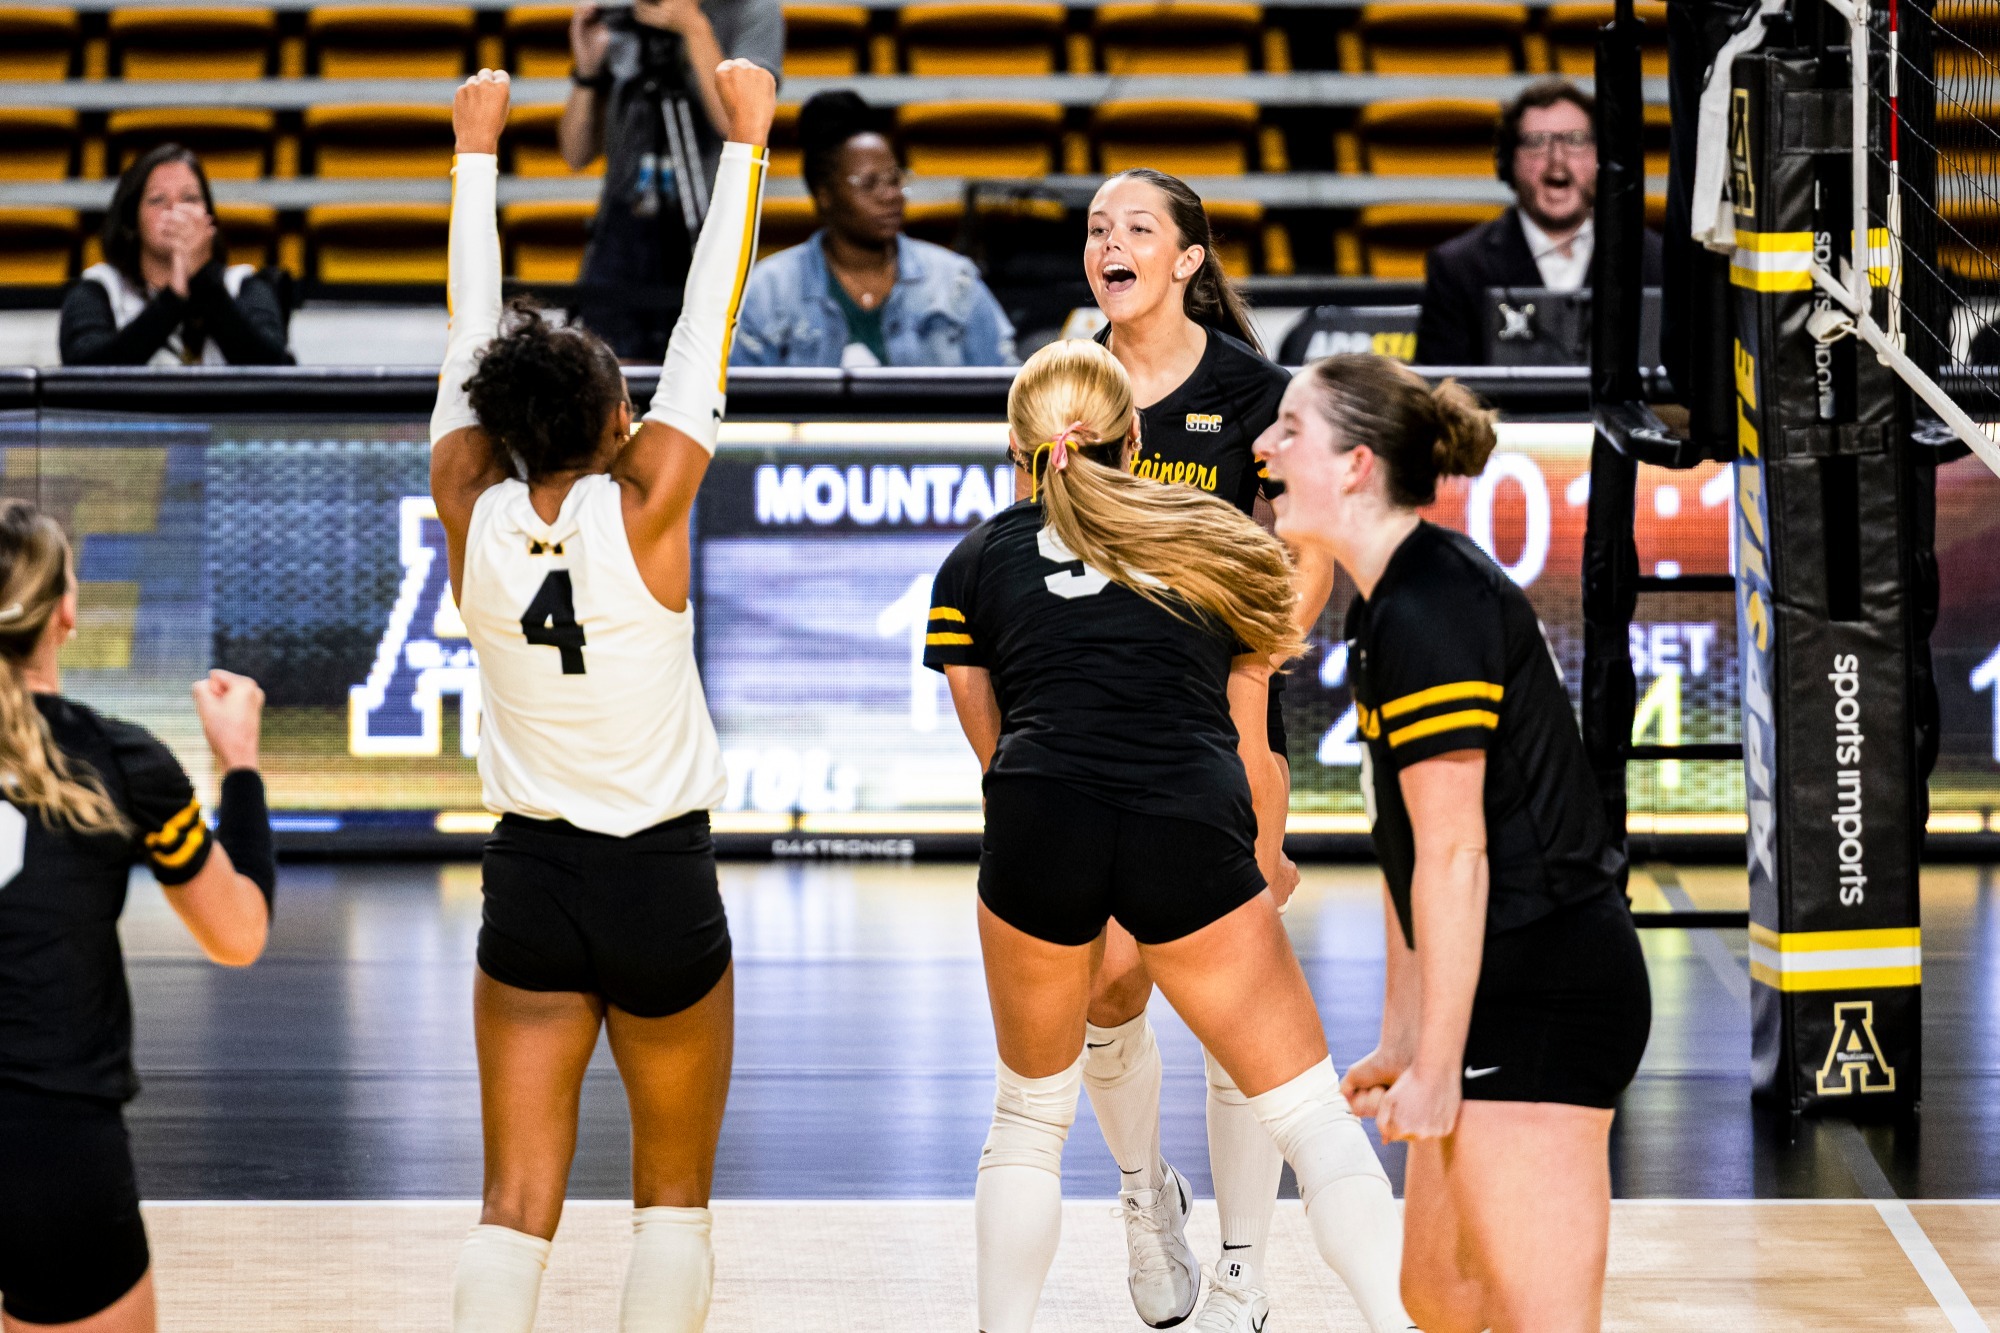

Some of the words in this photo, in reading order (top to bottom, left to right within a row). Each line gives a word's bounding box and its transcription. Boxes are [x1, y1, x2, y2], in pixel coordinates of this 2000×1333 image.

[1186, 413, 1223, 433] SBC
[756, 464, 1016, 525] MOUNTAI
[520, 569, 587, 675] 4
[1828, 654, 1865, 765] sports
[771, 838, 915, 857] DAKTRONICS
[1816, 1001, 1896, 1096] A
